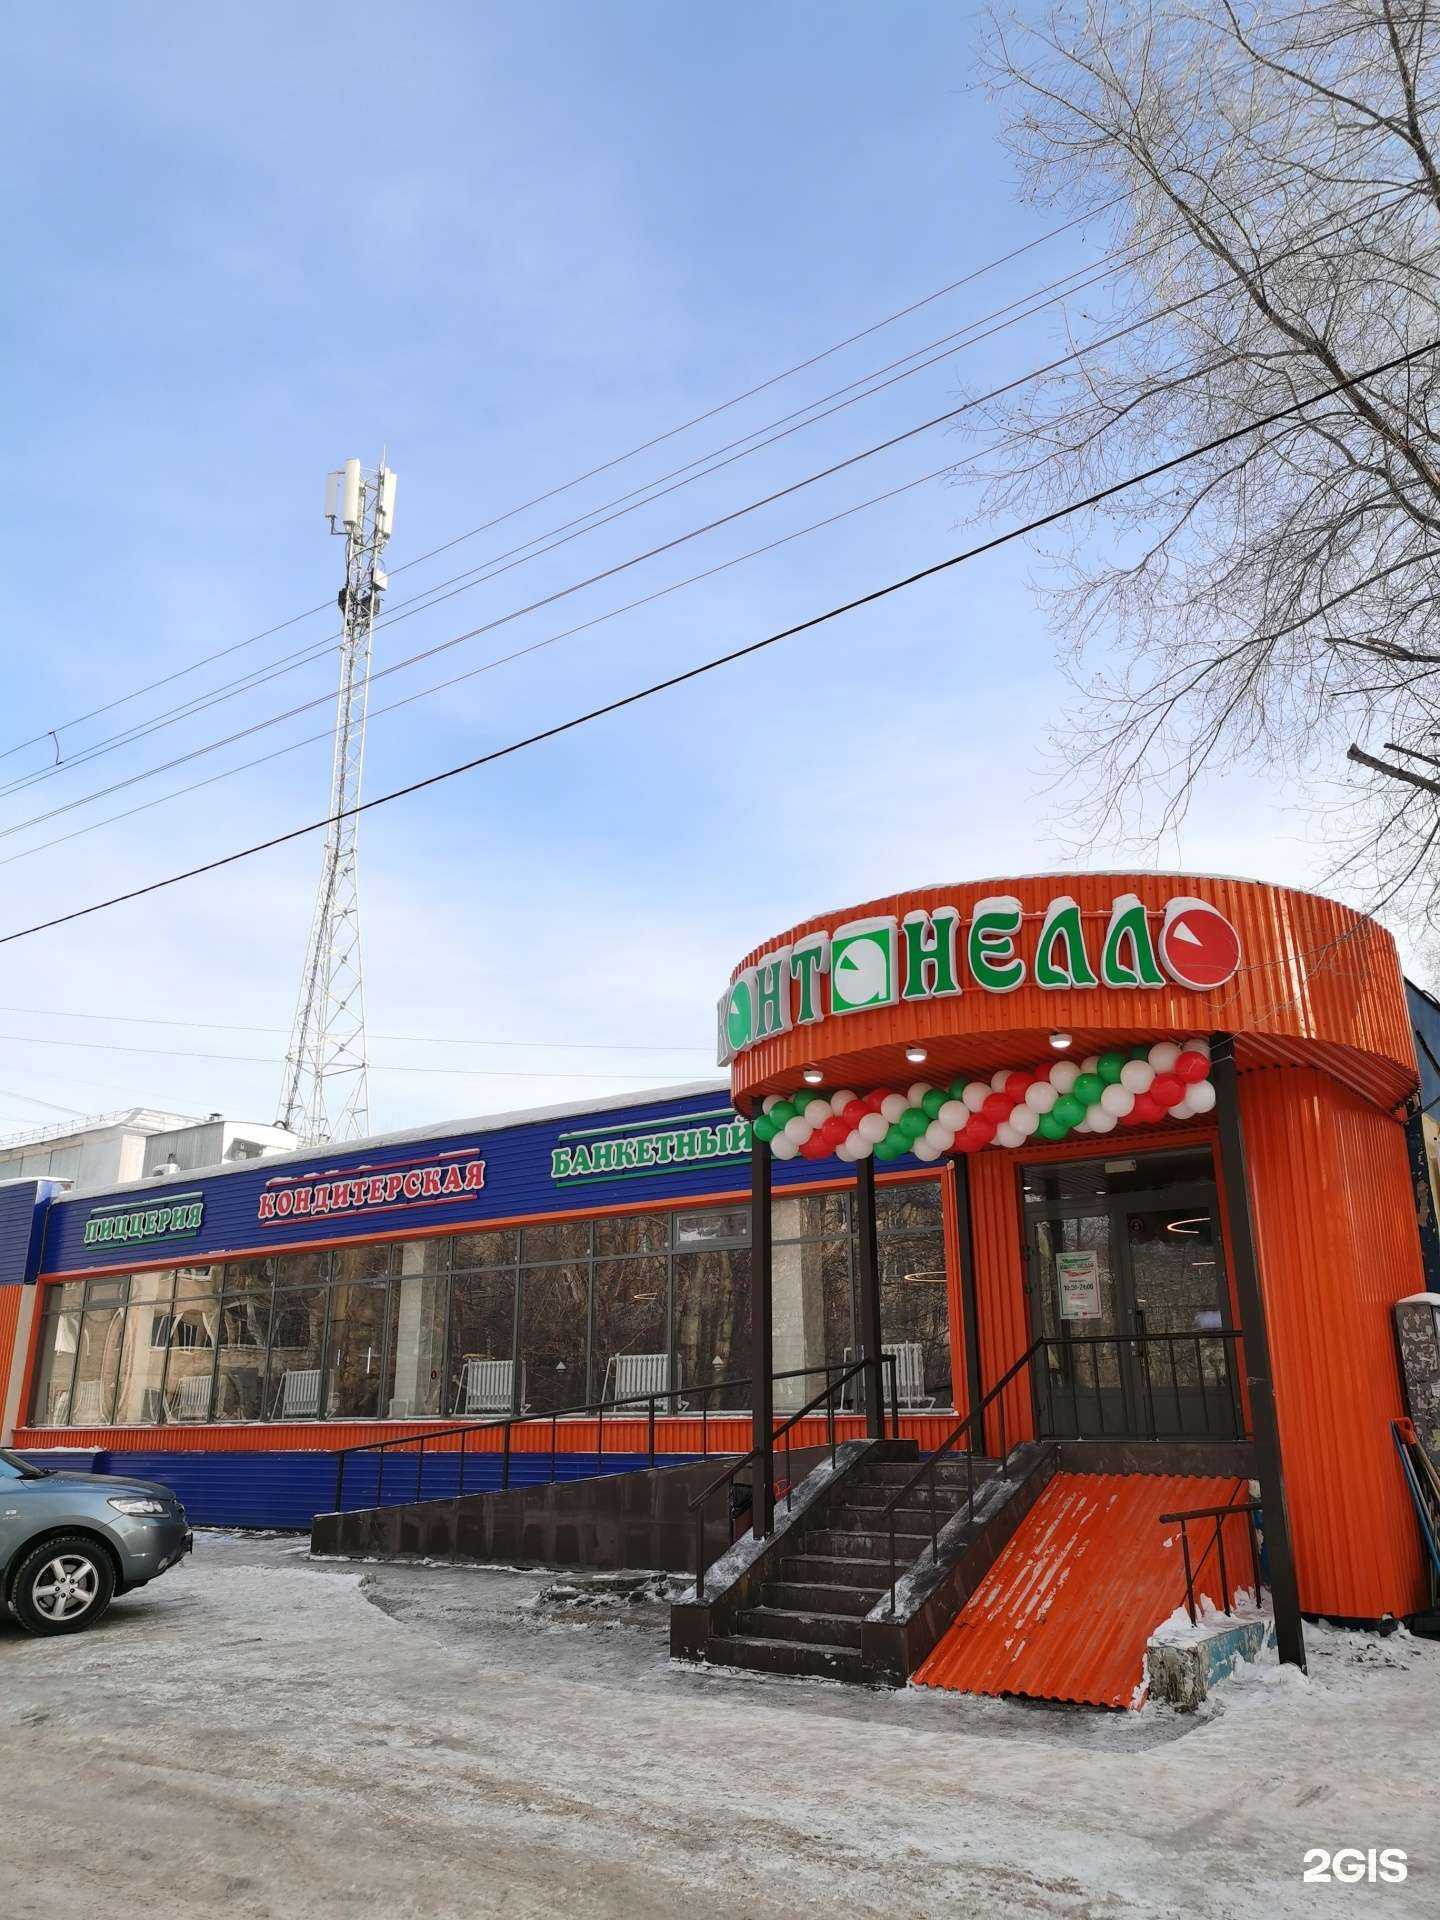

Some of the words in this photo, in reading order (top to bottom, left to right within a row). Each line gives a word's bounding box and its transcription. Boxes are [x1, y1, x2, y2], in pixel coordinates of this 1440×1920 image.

[551, 1117, 752, 1178] БАНКЕТНЫЙ
[258, 1160, 486, 1219] КОНДИТЕРСКАЯ
[84, 1203, 203, 1243] ПИЦЦЕРИЯ
